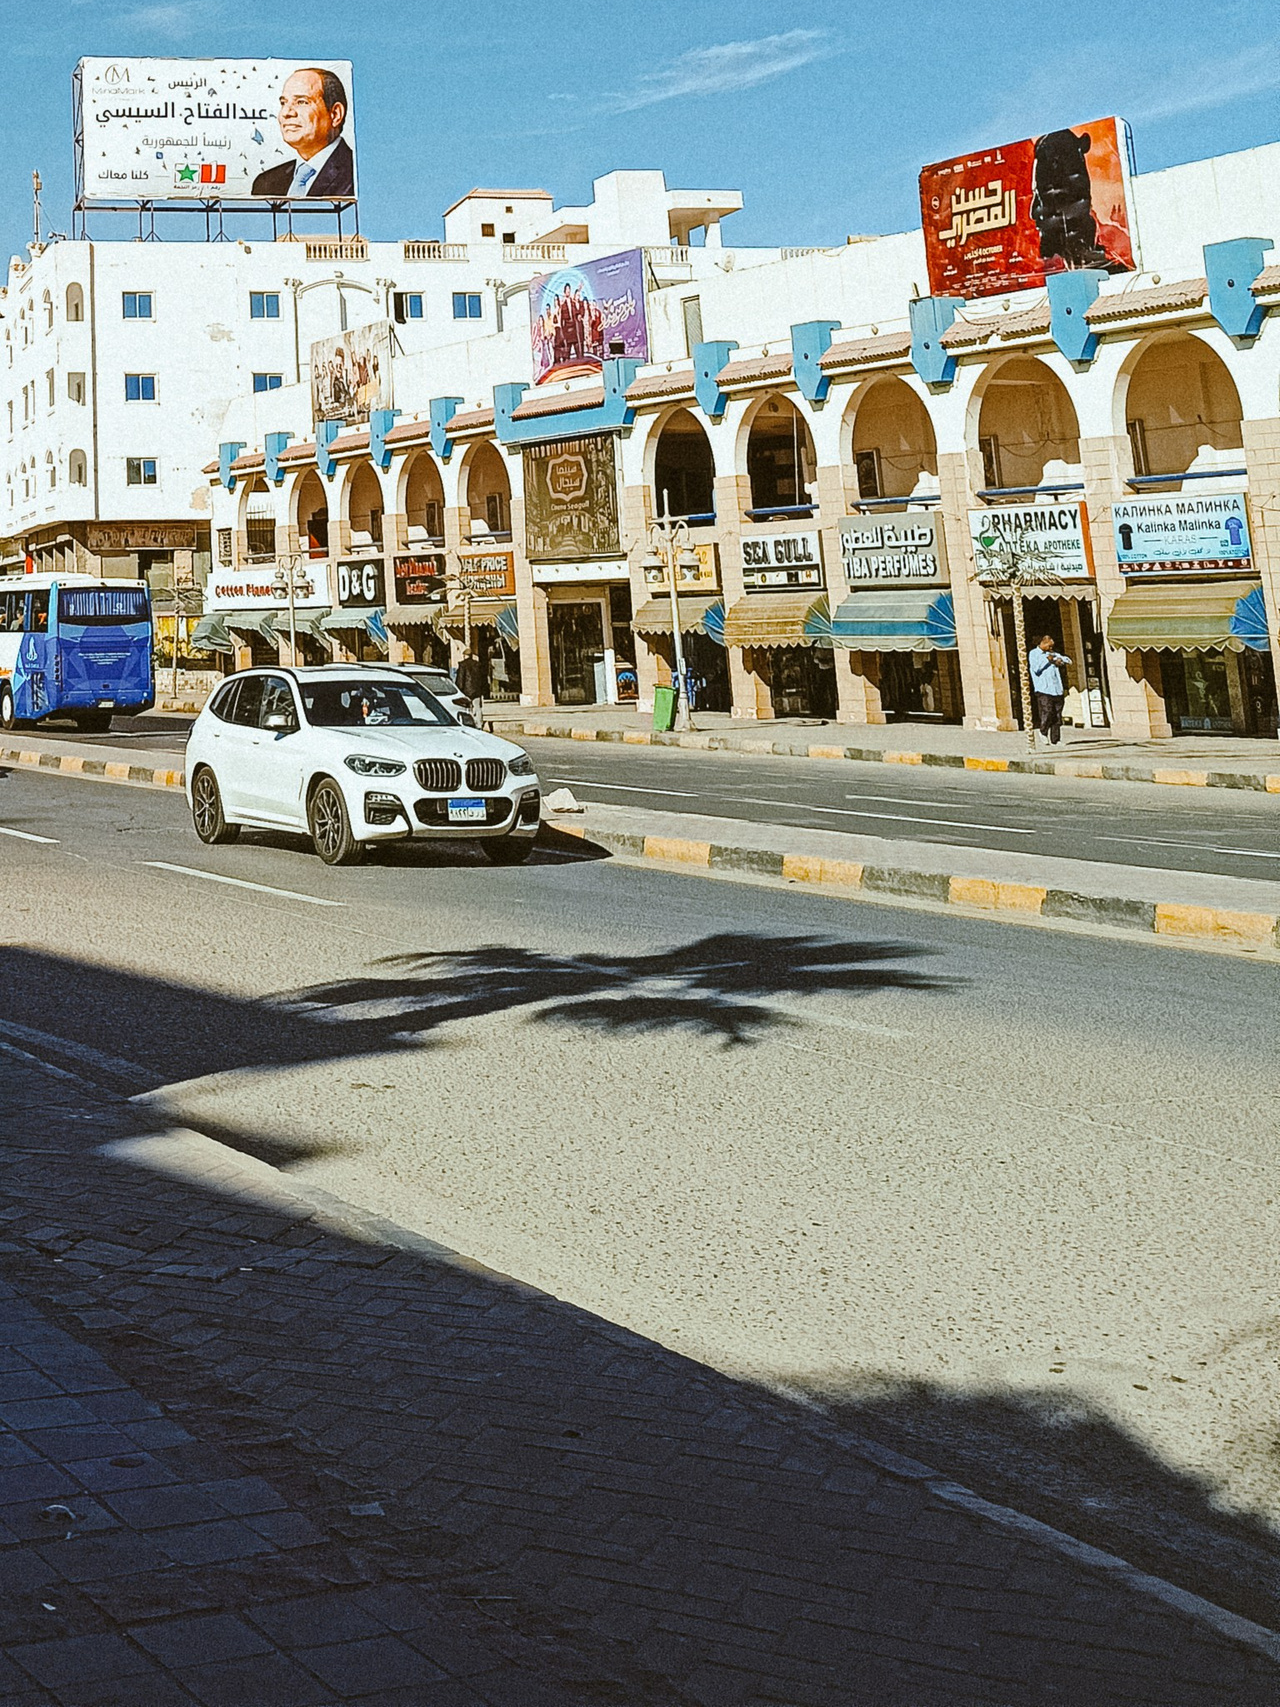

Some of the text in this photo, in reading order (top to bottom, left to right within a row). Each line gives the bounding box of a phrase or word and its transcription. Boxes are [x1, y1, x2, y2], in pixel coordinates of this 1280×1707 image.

[167, 77, 207, 91] الرئيس
[95, 101, 175, 128] السيسي
[141, 136, 200, 148] للجمهورية
[98, 168, 149, 180] كلنا معاك
[951, 179, 1003, 213] حسن
[938, 189, 1017, 249] المصري
[982, 244, 1004, 255] OCTOBER
[1114, 498, 1241, 519] КАЛИНКА МАЛИНКА
[991, 508, 1079, 533] PHARMACY
[1136, 518, 1222, 534] Kalinka Malinka
[884, 523, 933, 554] طيبة
[1043, 538, 1081, 551] APOTHEKE
[742, 537, 814, 565] SEA GULL
[480, 555, 509, 572] PRICE
[841, 552, 937, 580] TIBA PERFUMES
[246, 583, 273, 598] Plane
[338, 563, 378, 602] D&G
